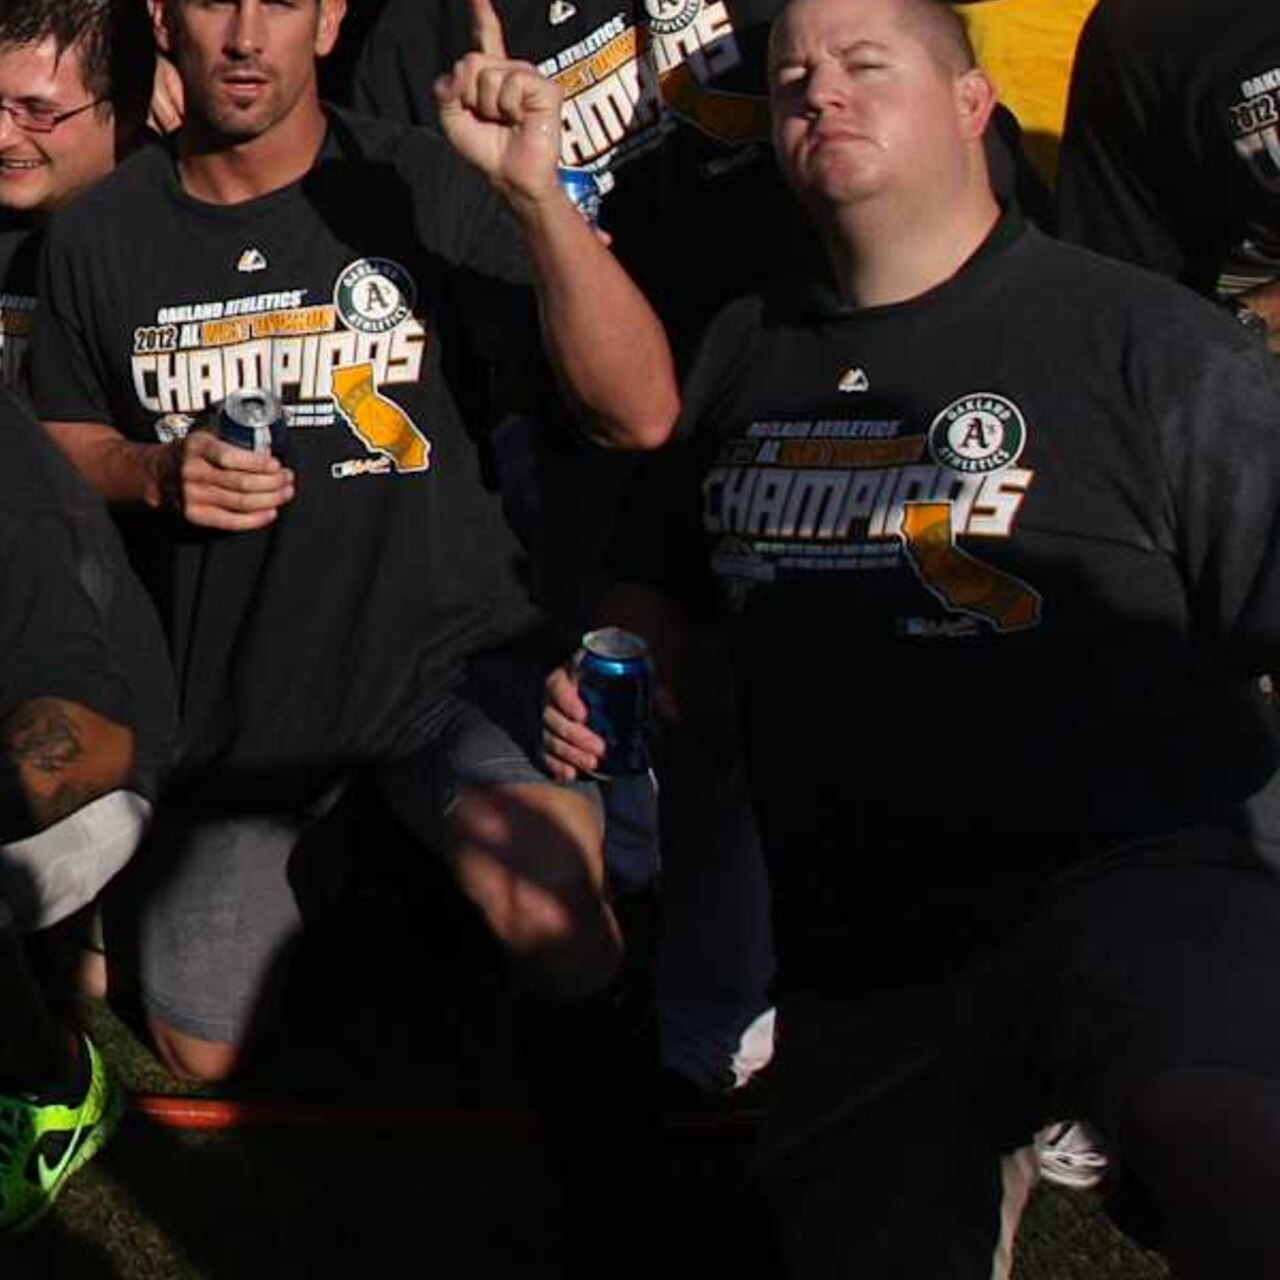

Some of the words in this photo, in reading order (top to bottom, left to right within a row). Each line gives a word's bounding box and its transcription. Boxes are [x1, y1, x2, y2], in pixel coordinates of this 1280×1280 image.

[157, 302, 225, 324] OAKLAND
[224, 289, 304, 317] ATHLETICS
[133, 324, 178, 352] 2012
[179, 323, 201, 347] AL
[130, 317, 426, 413] CHAMPIONS
[943, 397, 1013, 421] OAKLAND
[938, 446, 1012, 472] ATHLETICS
[702, 465, 1037, 540] CHAMPIONS
